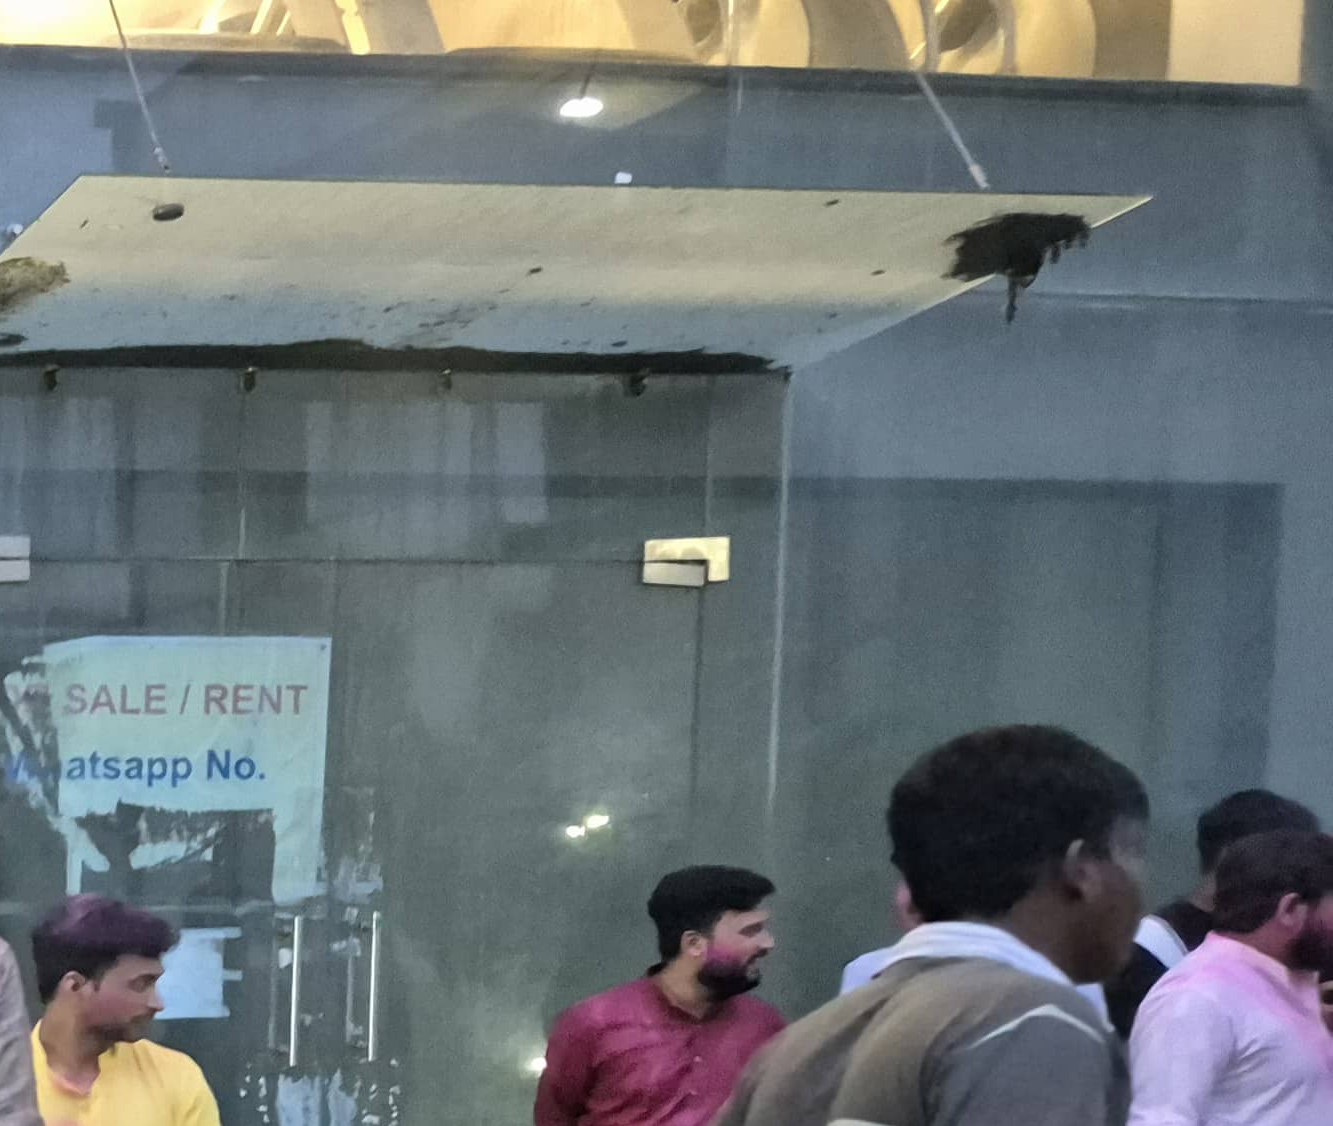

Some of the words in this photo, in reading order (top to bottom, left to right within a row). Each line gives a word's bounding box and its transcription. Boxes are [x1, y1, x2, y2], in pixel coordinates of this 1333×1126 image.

[65, 683, 167, 715] SALE
[180, 685, 190, 715] /
[204, 683, 308, 715] RENT
[206, 750, 266, 780] No.
